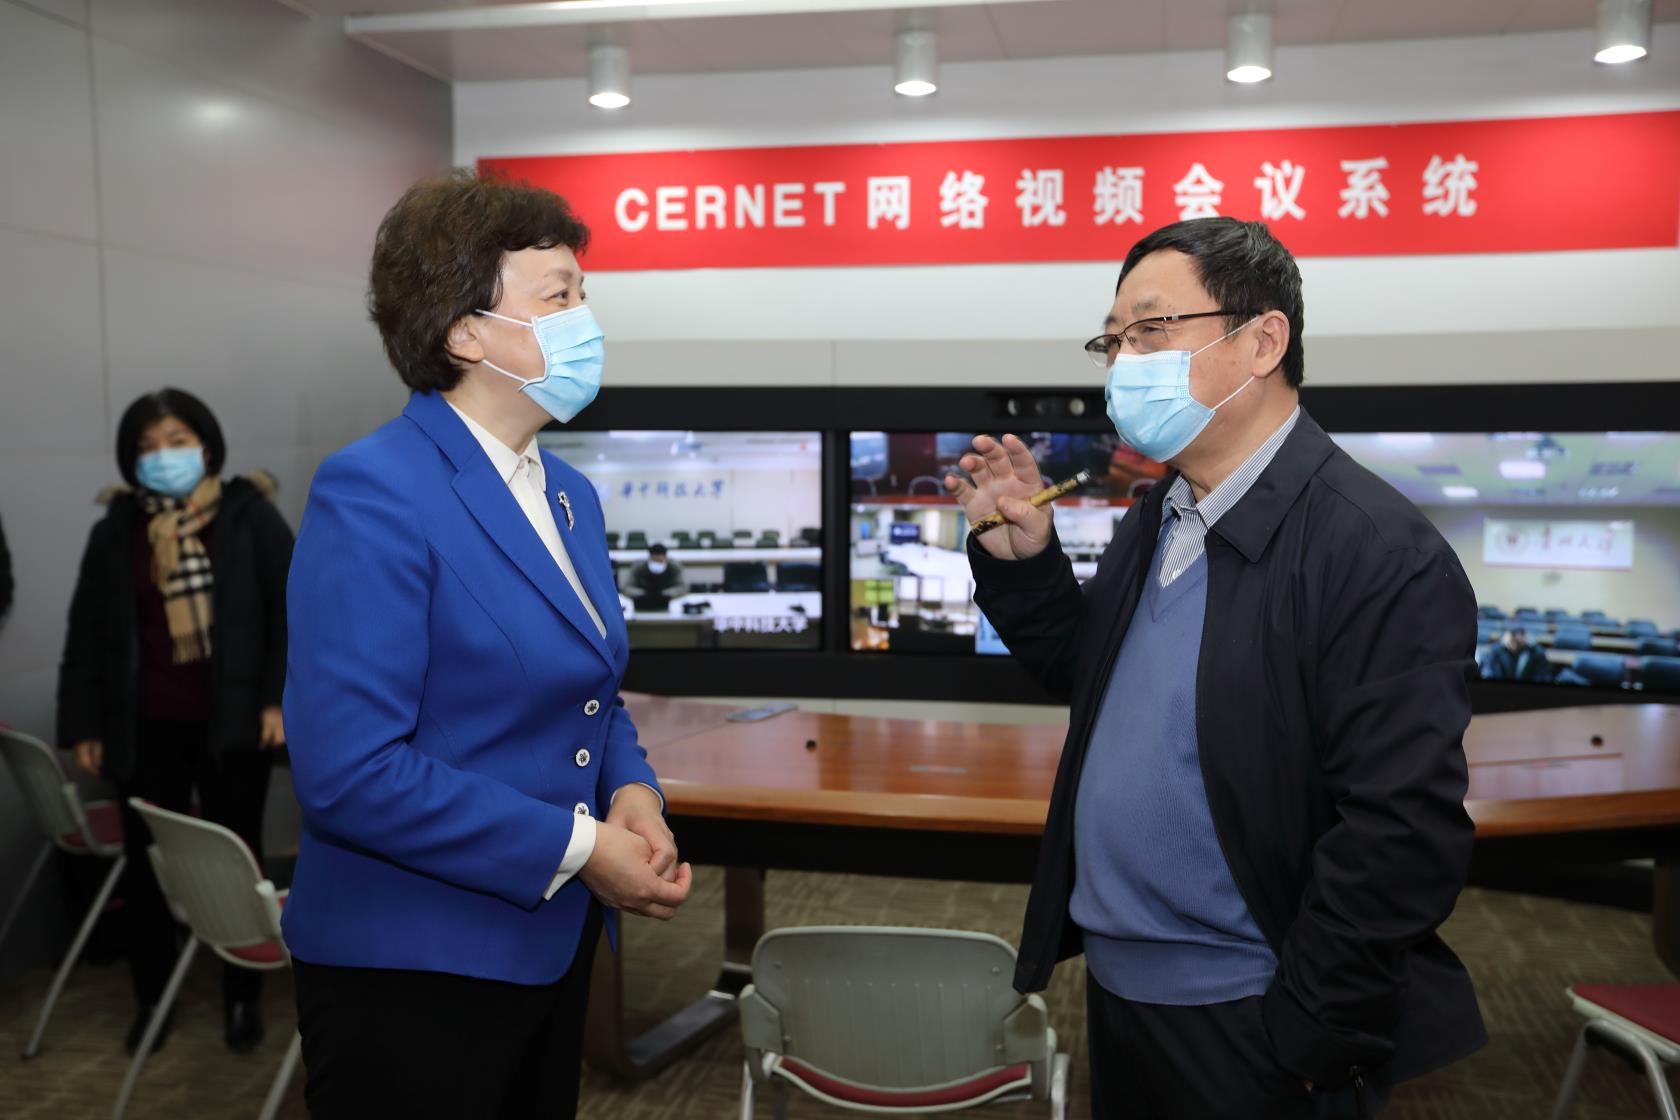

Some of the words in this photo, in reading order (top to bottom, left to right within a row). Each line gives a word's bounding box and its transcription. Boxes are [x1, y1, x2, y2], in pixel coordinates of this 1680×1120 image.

[615, 182, 846, 232] CERNET
[866, 153, 1479, 230] 网络视频会议系统
